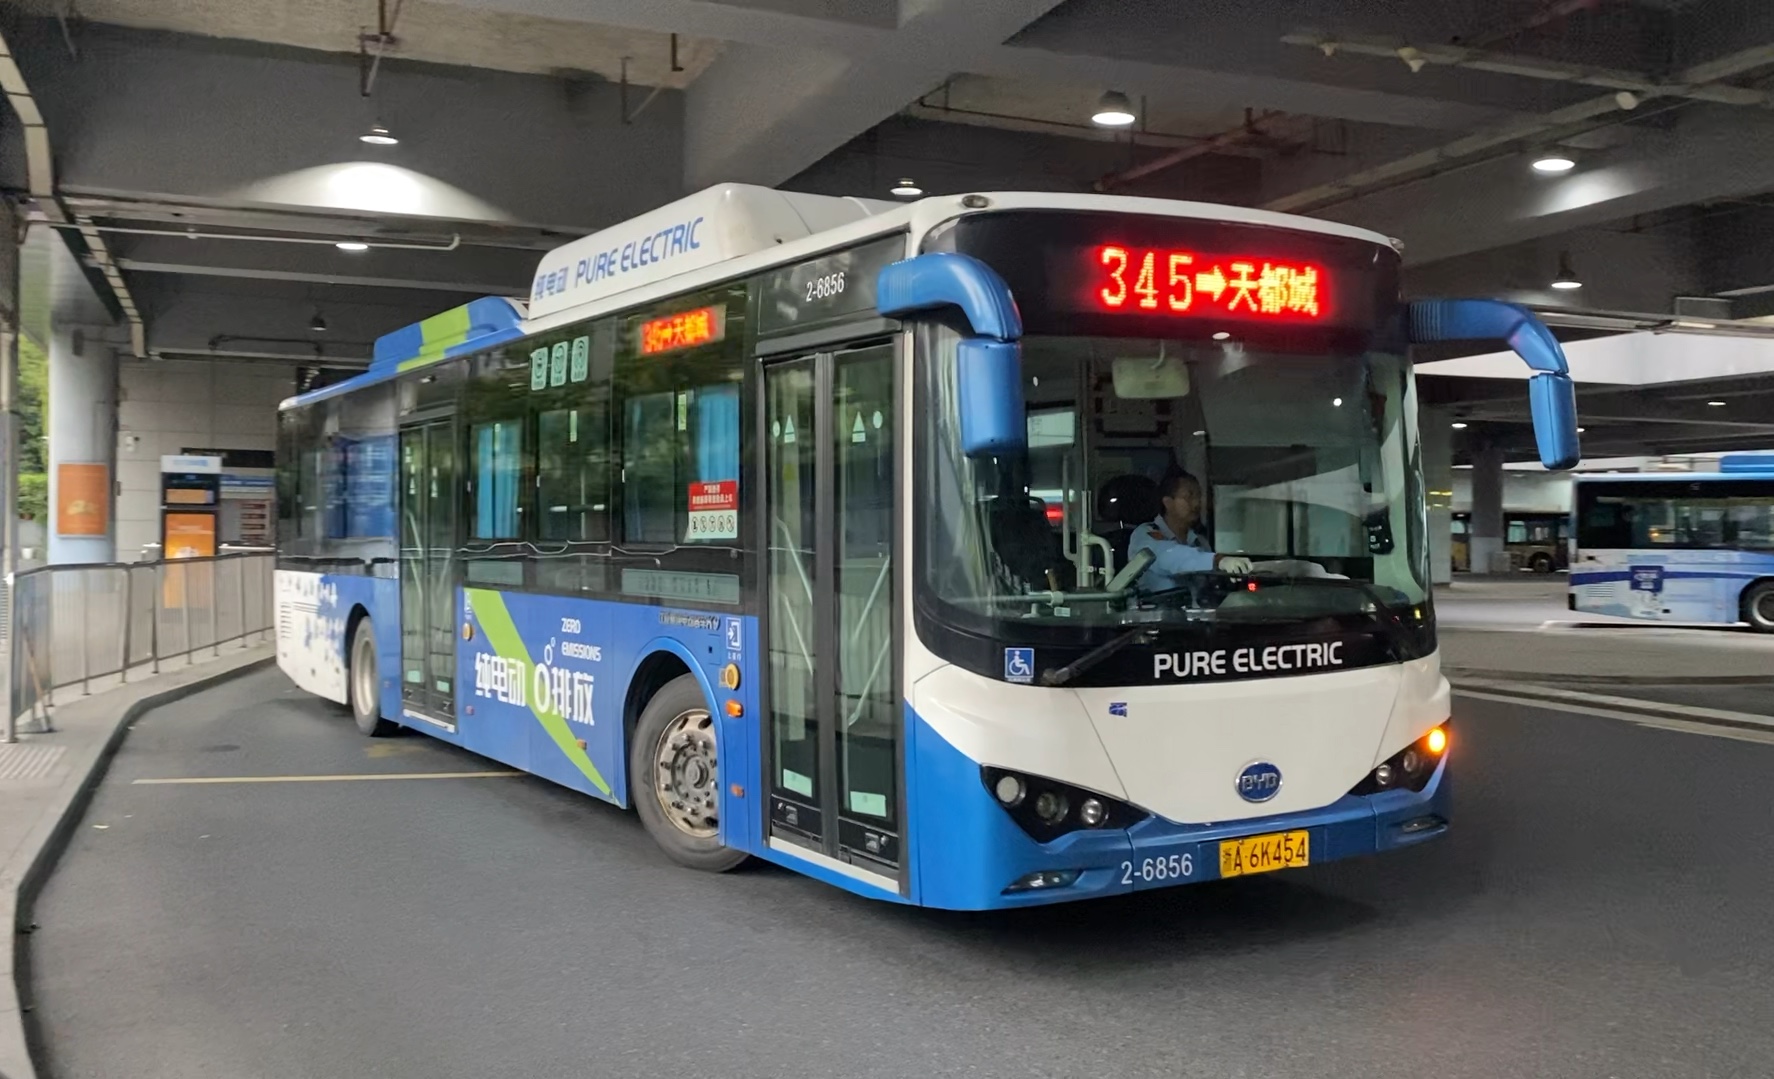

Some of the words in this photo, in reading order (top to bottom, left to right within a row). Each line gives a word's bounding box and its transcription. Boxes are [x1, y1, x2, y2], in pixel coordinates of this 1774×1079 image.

[574, 247, 619, 288] PURE
[620, 216, 704, 273] ELECTRIC
[805, 271, 845, 303] 2-6856
[1102, 247, 1193, 311] 345
[1228, 262, 1318, 317] 天都城
[1153, 649, 1227, 679] PURE
[1232, 640, 1343, 674] ELECTRIC
[474, 651, 527, 708] 纯电动
[1240, 772, 1279, 792] BYD
[1120, 852, 1194, 886] 2-6856
